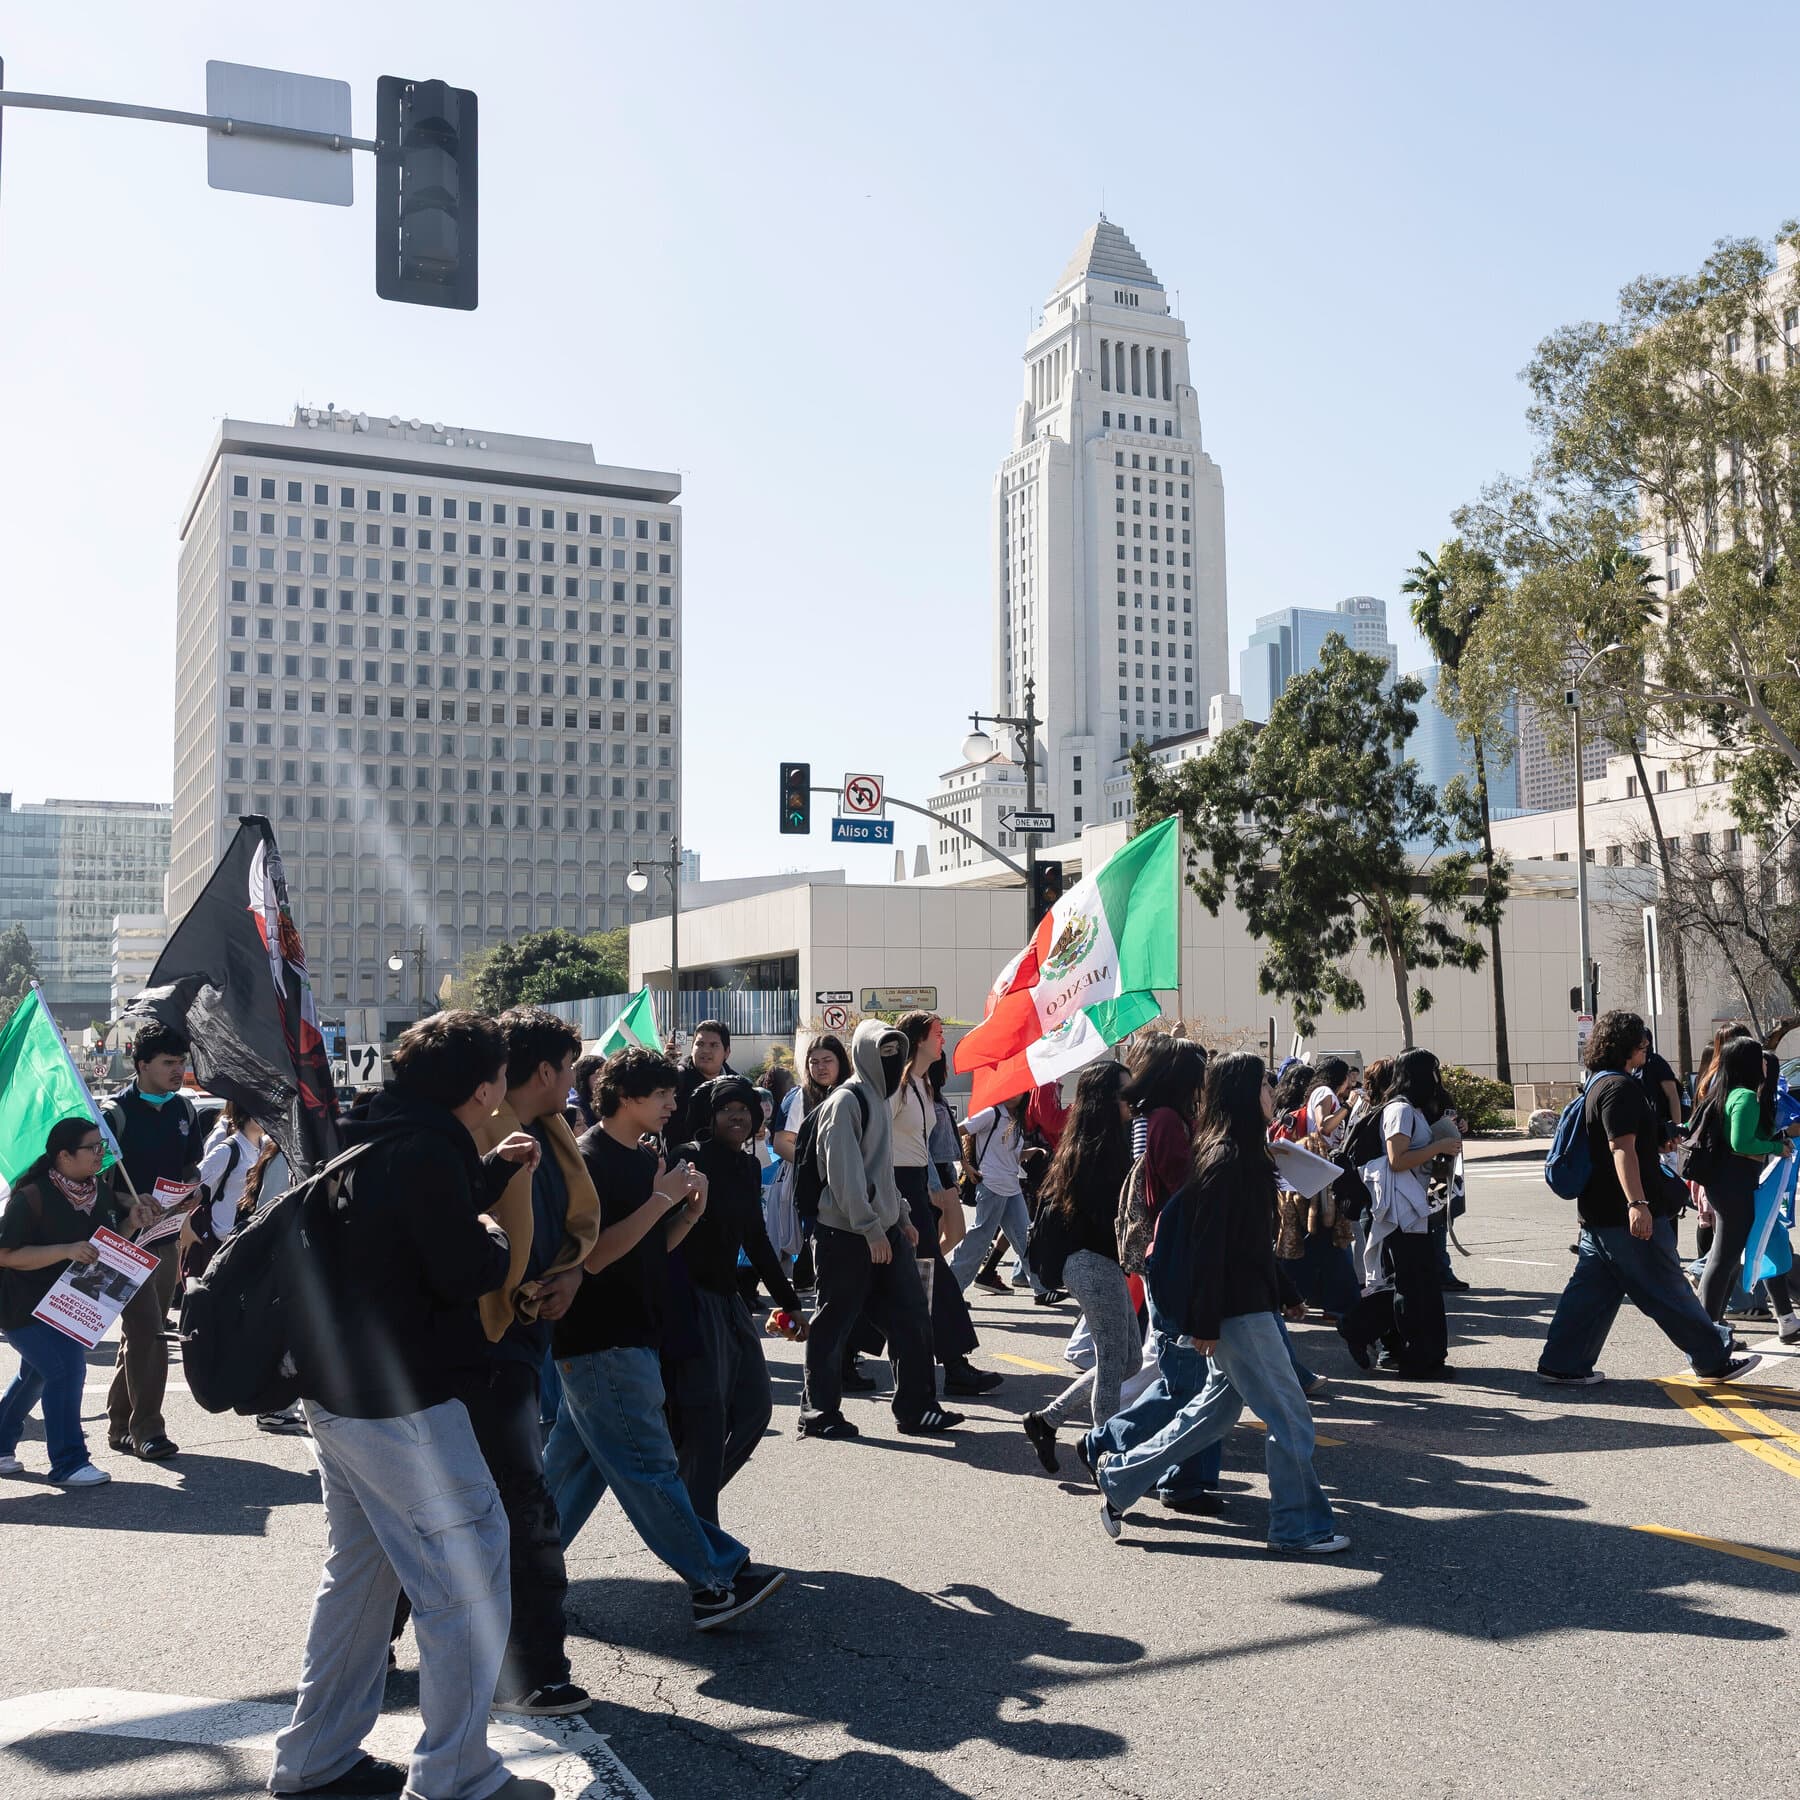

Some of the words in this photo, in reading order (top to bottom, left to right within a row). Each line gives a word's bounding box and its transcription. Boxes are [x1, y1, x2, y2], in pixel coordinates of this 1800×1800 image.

[837, 824, 869, 838] Aliso
[874, 825, 888, 839] St
[1015, 818, 1031, 827] ONE
[1033, 818, 1049, 828] WAY
[162, 1184, 184, 1193] MOST
[102, 1235, 122, 1249] MOST
[121, 1245, 150, 1264] WANTED
[47, 1300, 99, 1332] MINNEAPOLIS
[48, 1293, 75, 1311] RENEE
[74, 1308, 97, 1324] GOOD
[95, 1320, 106, 1329] IN
[59, 1292, 103, 1320] EXECUTING
